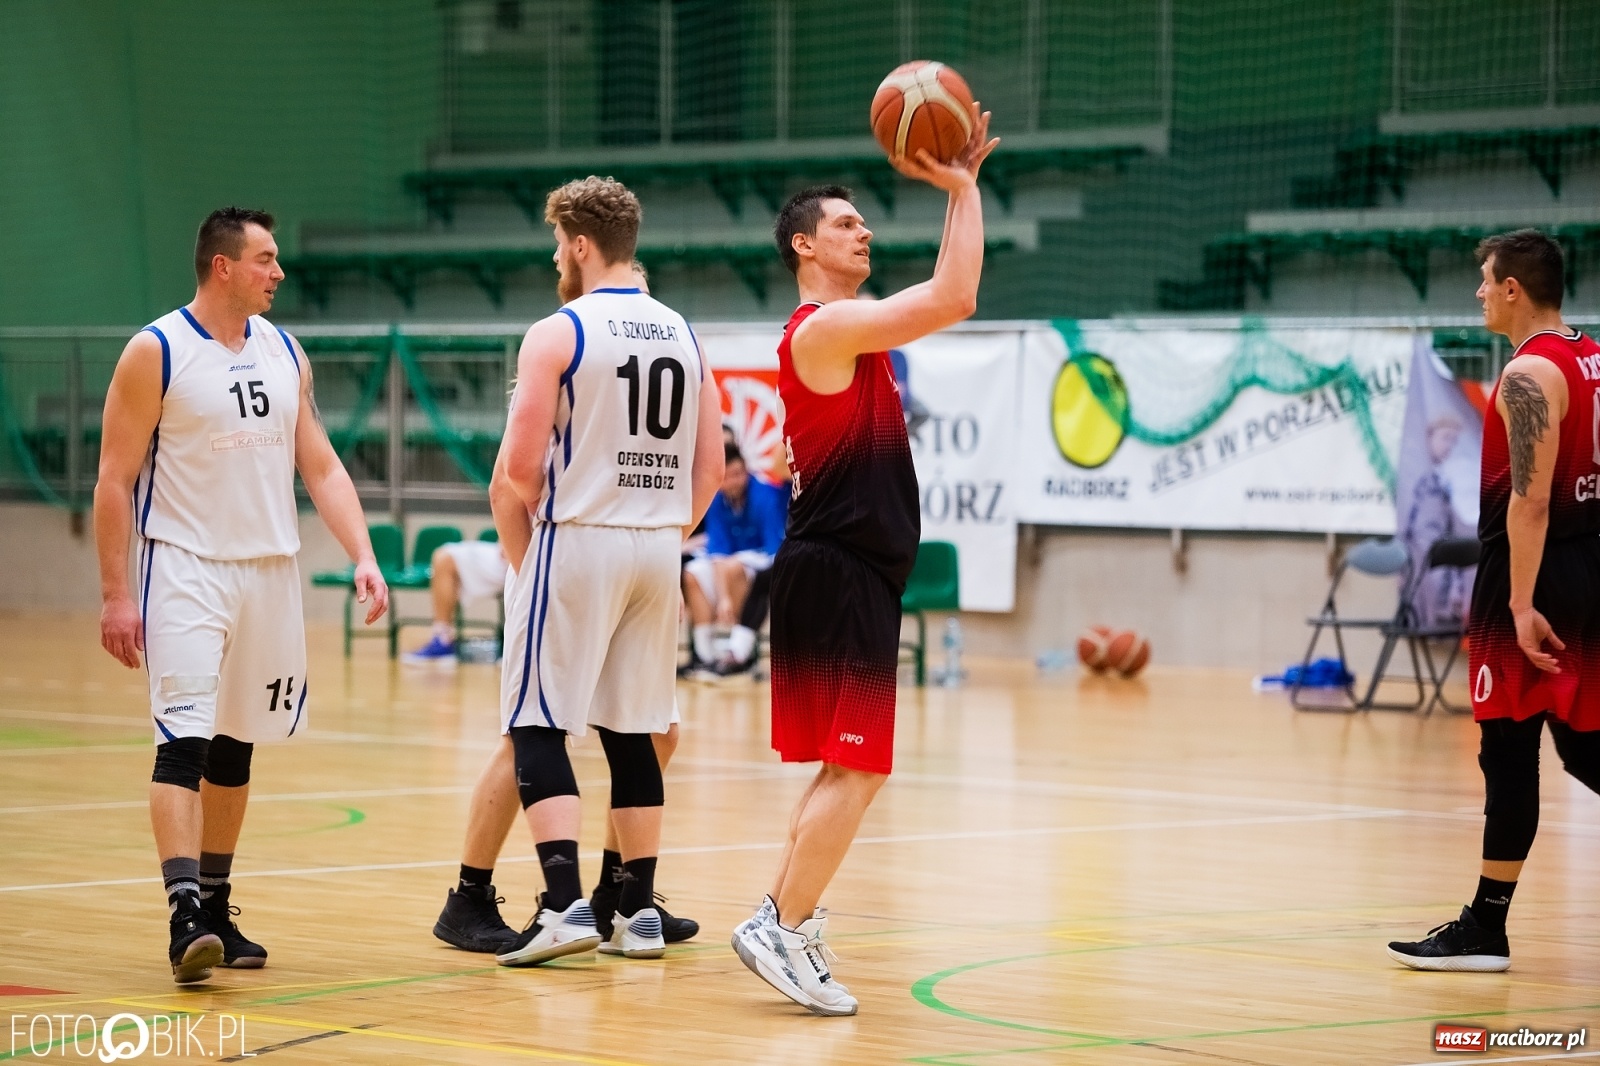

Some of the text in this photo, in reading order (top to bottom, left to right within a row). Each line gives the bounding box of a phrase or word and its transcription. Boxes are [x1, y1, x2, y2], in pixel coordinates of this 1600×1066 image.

[608, 320, 679, 341] O. SZKURŁAT
[229, 380, 270, 418] 15
[617, 355, 685, 439] 10
[238, 436, 283, 446] KAMPKA
[617, 451, 679, 469] OFENSYWA
[1150, 444, 1206, 492] JEST
[1214, 429, 1238, 458] W
[617, 471, 675, 490] RACIBÓRZ
[921, 466, 1006, 526] ÓRZ
